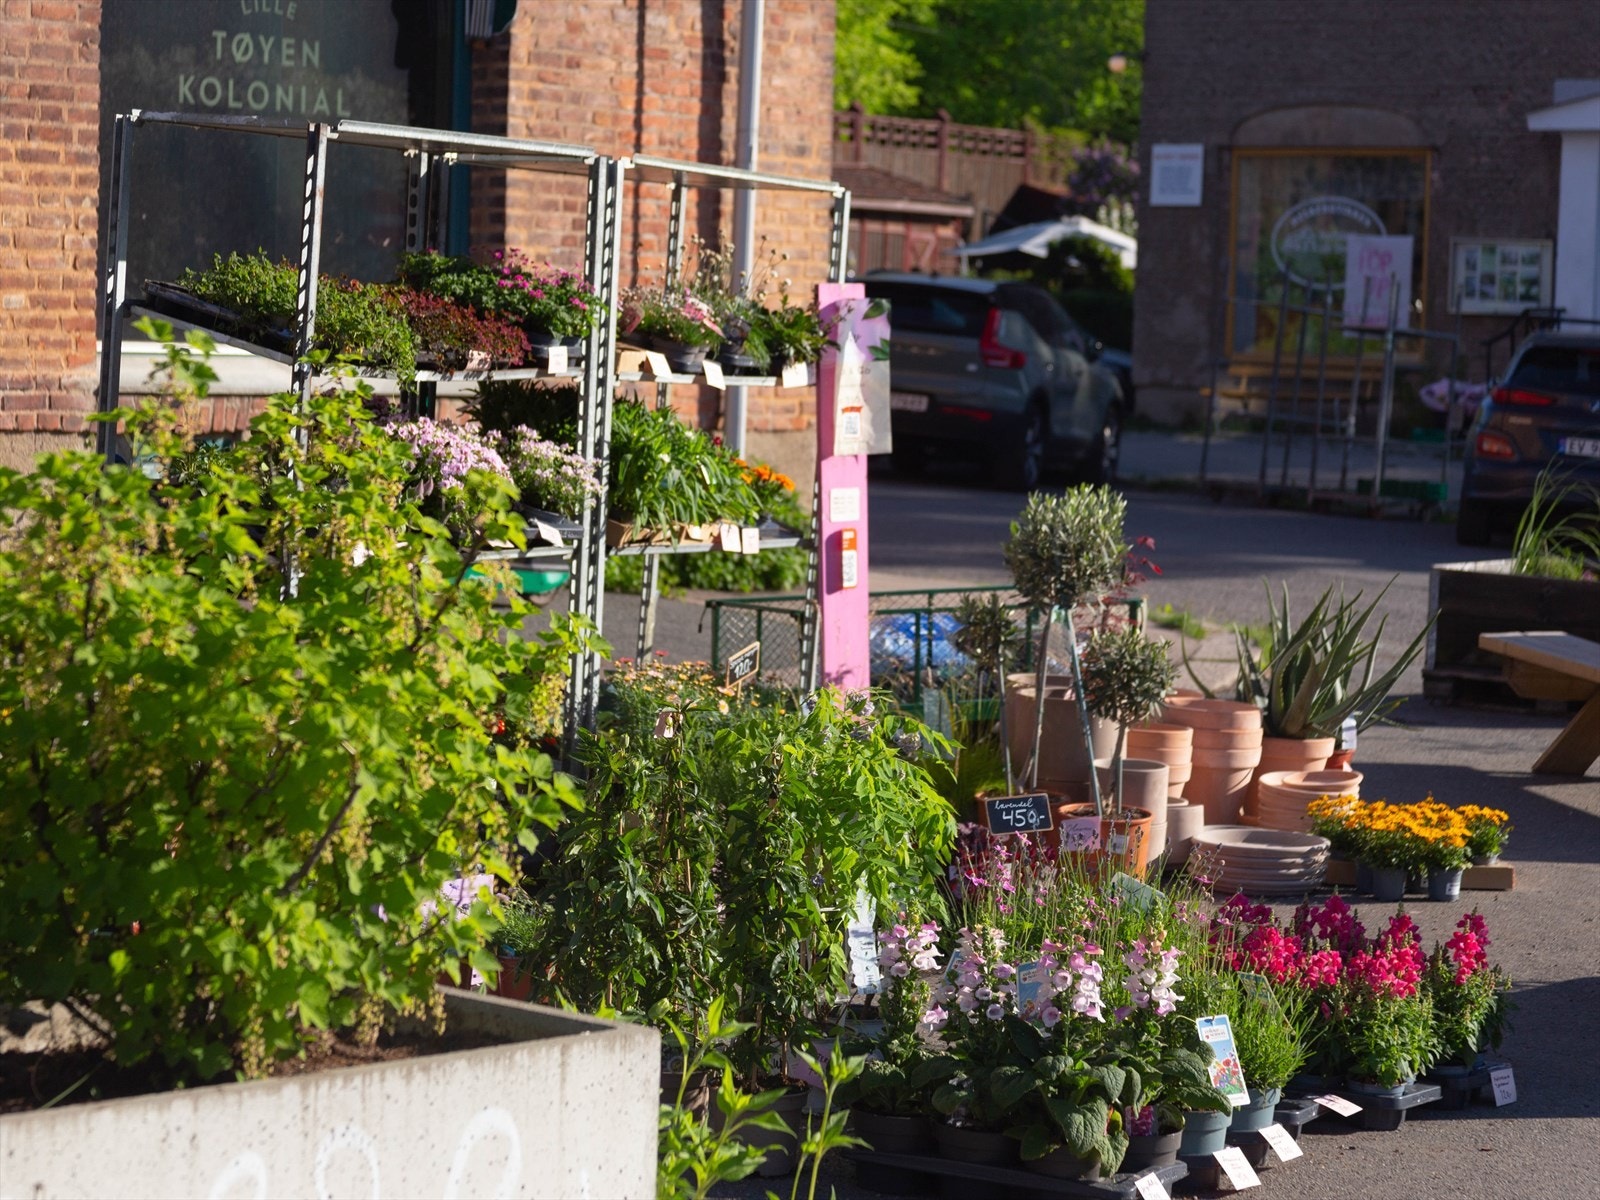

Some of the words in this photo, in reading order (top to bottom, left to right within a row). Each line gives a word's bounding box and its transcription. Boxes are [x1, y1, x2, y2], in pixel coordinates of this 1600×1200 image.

[241, 0, 298, 20] LILLE
[211, 30, 320, 69] TØYEN
[178, 74, 351, 116] KOLONIAL
